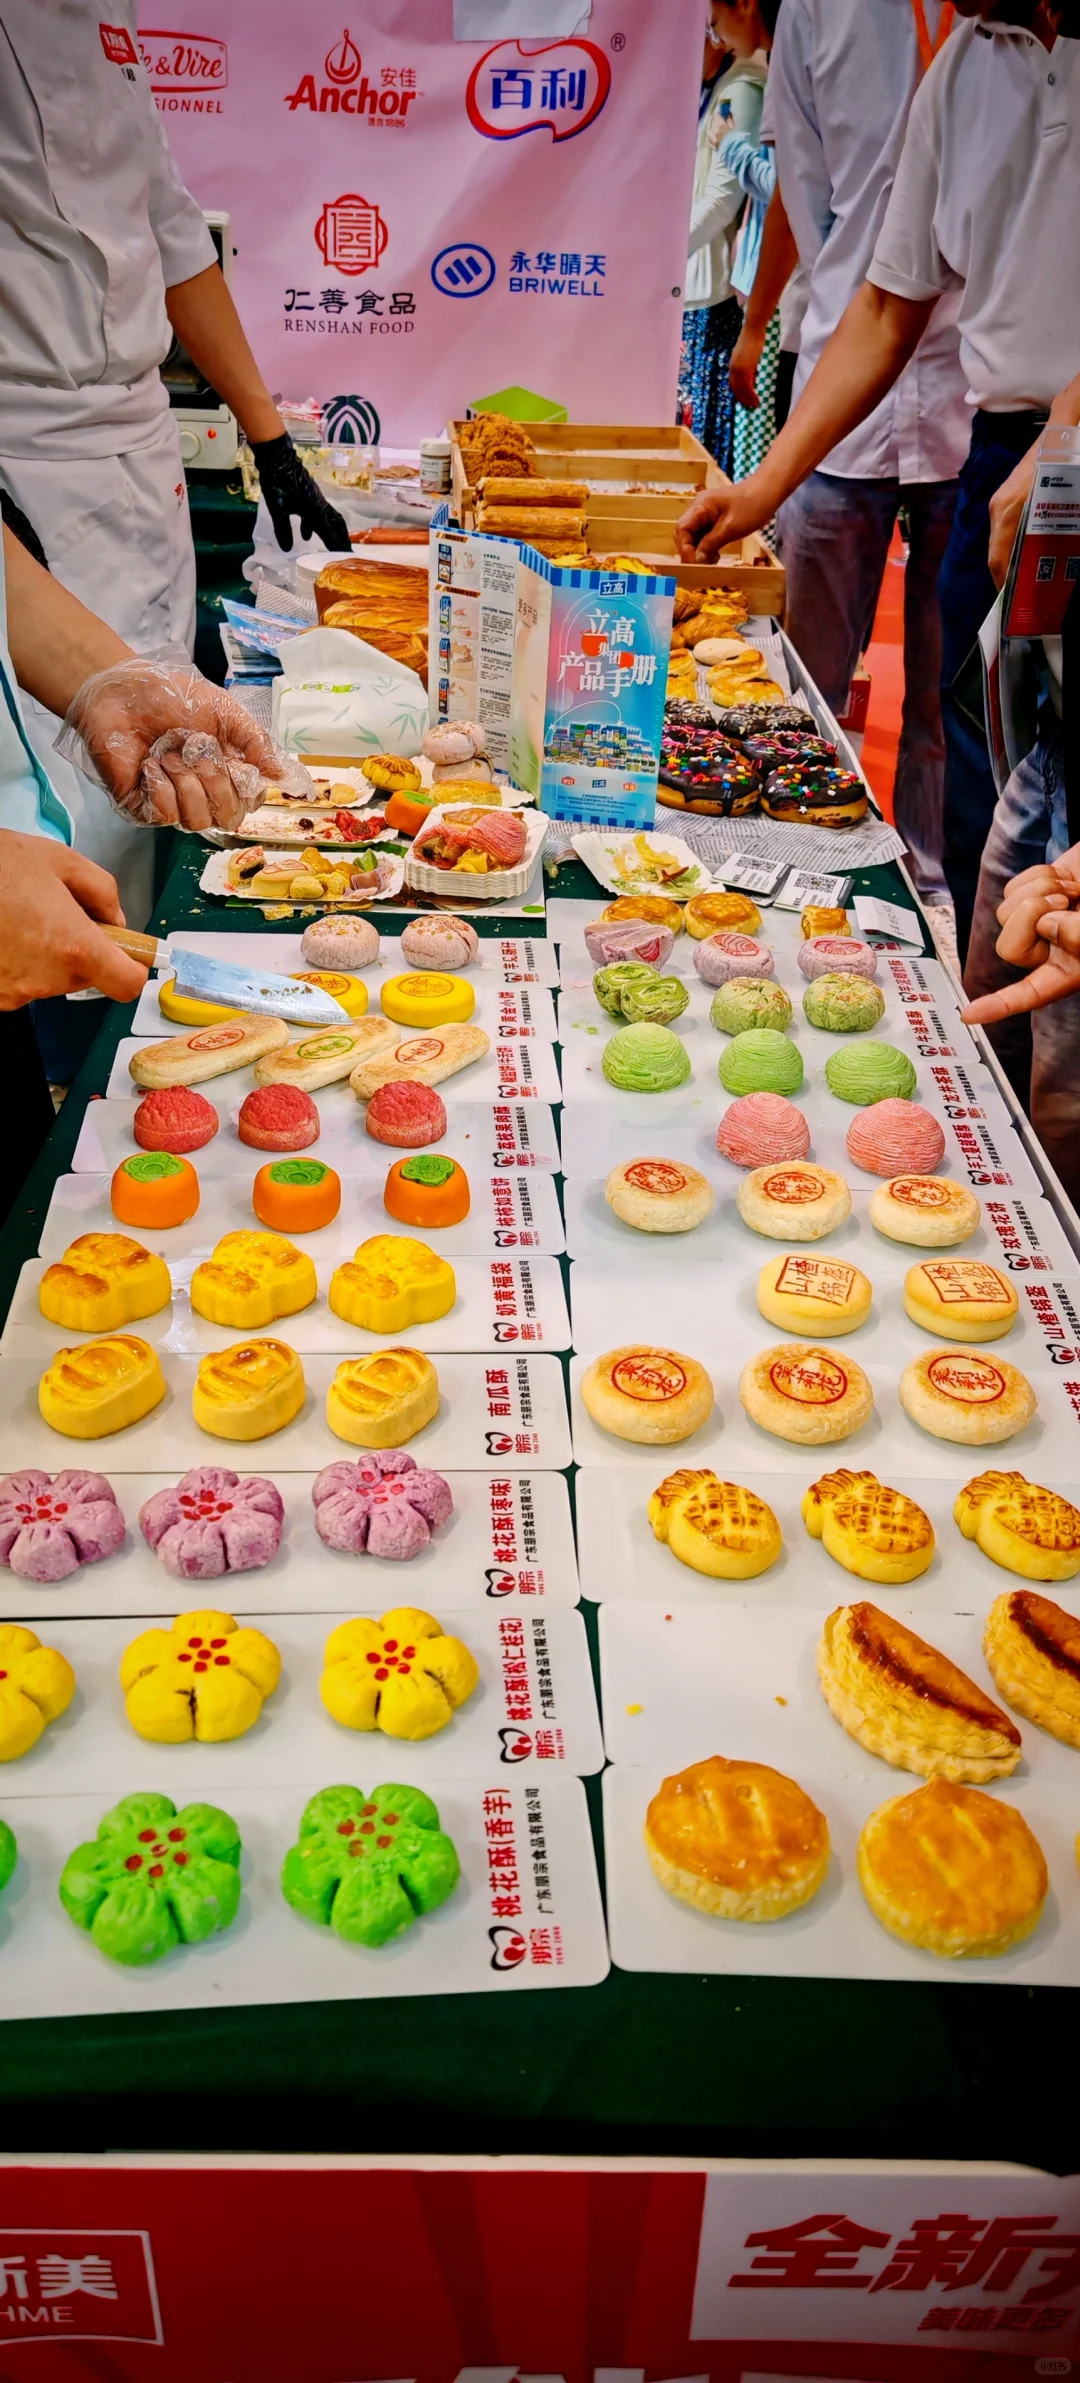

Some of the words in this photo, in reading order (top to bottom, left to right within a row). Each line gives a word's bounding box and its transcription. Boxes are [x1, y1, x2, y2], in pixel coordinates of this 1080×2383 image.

[284, 75, 416, 116] Anchor
[381, 67, 416, 87] 安佳
[489, 68, 586, 110] 百利
[509, 252, 606, 277] 永华晴天
[284, 289, 416, 316] 仁善食品
[509, 277, 604, 296] BRIWELL
[284, 318, 363, 334] RENSHAN
[370, 321, 414, 334] FOOD
[602, 582, 624, 594] 立高
[586, 608, 636, 647] 立高
[557, 650, 658, 698] 产品手册
[498, 991, 517, 1023] 黄金小饼
[905, 1010, 933, 1043] 牛油果酥
[930, 1066, 961, 1103] 龙井茶酥
[493, 1106, 516, 1150] 荔枝果肉酥
[490, 1178, 516, 1227] 柿柿如意饼
[985, 1202, 1022, 1249] 玫瑰花饼
[1012, 1201, 1043, 1251] 广东朋宗食品有限公司
[490, 1263, 517, 1316] 奶黄福袋
[519, 1260, 537, 1318] 广东朋宗食品有限公司
[1024, 1286, 1066, 1339] 山楂锅盔
[485, 1369, 511, 1417] 南瓜酥
[516, 1358, 533, 1427] 广东朋宗食品有限公司
[515, 1434, 532, 1454] 朋宗
[489, 1479, 518, 1563] 桃花酥(枣味)
[519, 1479, 538, 1563] 广东朋宗食品有限公司
[518, 1571, 536, 1595] 朋宗
[498, 1618, 532, 1721] 桃花酥(松仁桂花)
[532, 1618, 556, 1719] 广东朋宗食品有限公司
[535, 1730, 556, 1759] 朋宗
[482, 1788, 523, 1918] 桃花酥(香芋)
[525, 1788, 554, 1914] 广东朋宗食品有限公司
[529, 1928, 553, 1965] 朋宗
[917, 2307, 1074, 2332] 美味更多
